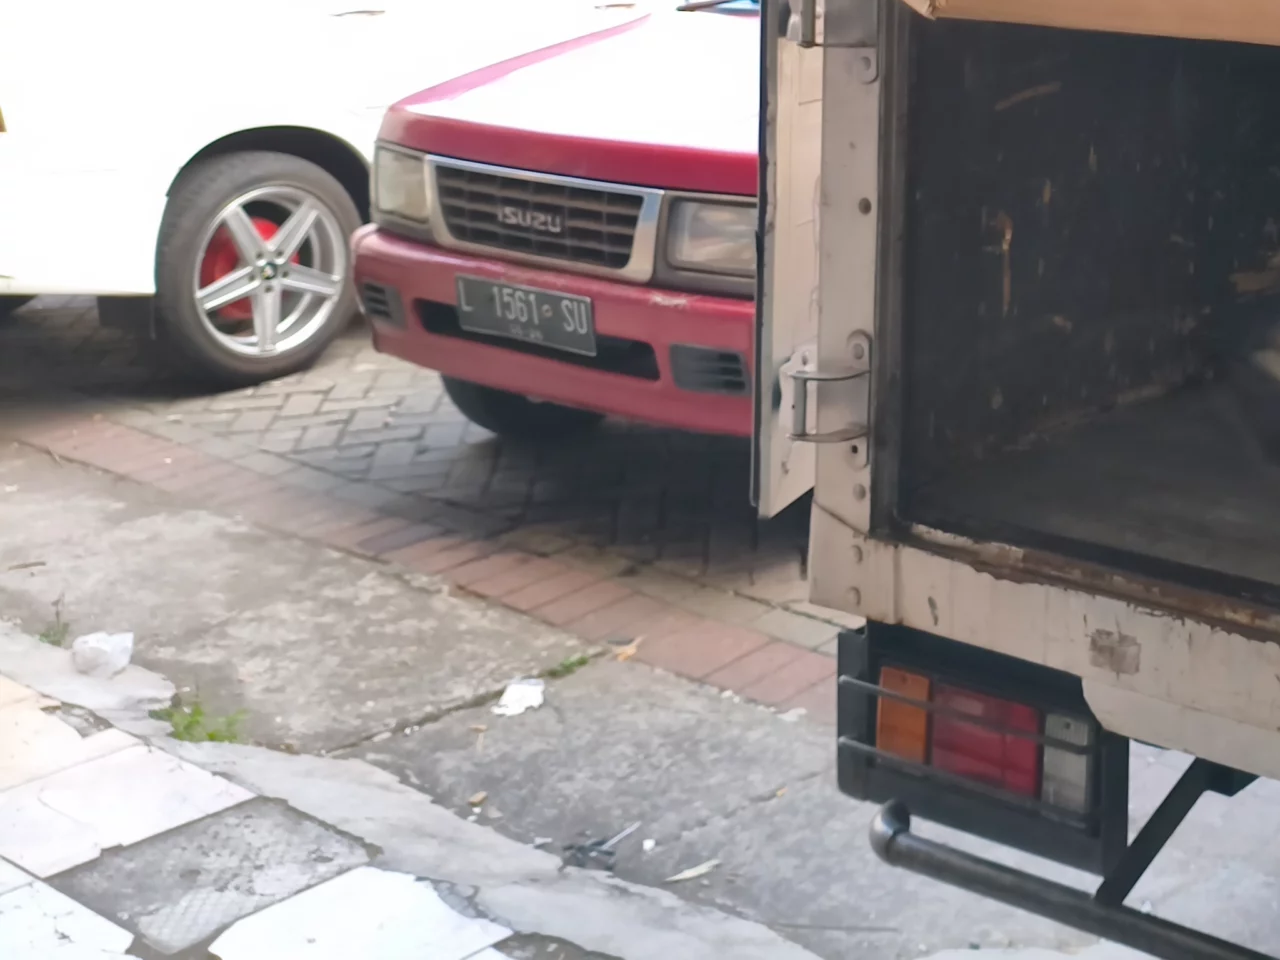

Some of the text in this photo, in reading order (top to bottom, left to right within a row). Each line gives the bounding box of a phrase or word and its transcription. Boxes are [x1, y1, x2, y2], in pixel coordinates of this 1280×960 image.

[498, 206, 561, 233] ISUZU
[458, 279, 588, 335] L 1561 SU
